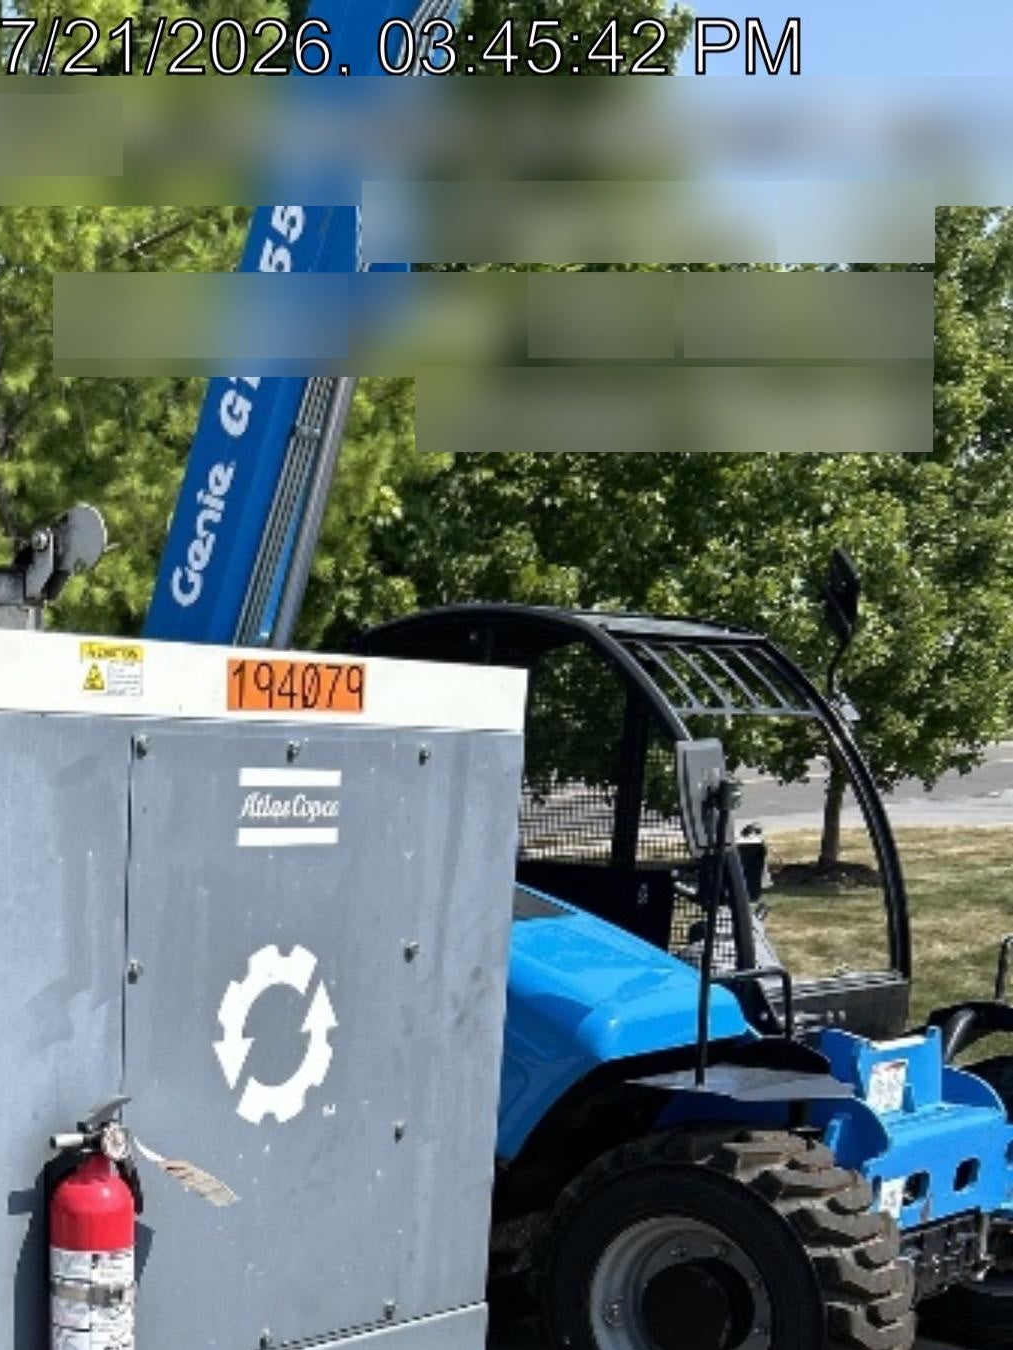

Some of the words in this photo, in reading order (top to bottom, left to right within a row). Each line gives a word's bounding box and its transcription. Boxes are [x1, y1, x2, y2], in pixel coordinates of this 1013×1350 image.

[171, 461, 236, 607] Genie
[233, 660, 364, 709] 194079
[238, 792, 291, 819] Atlas
